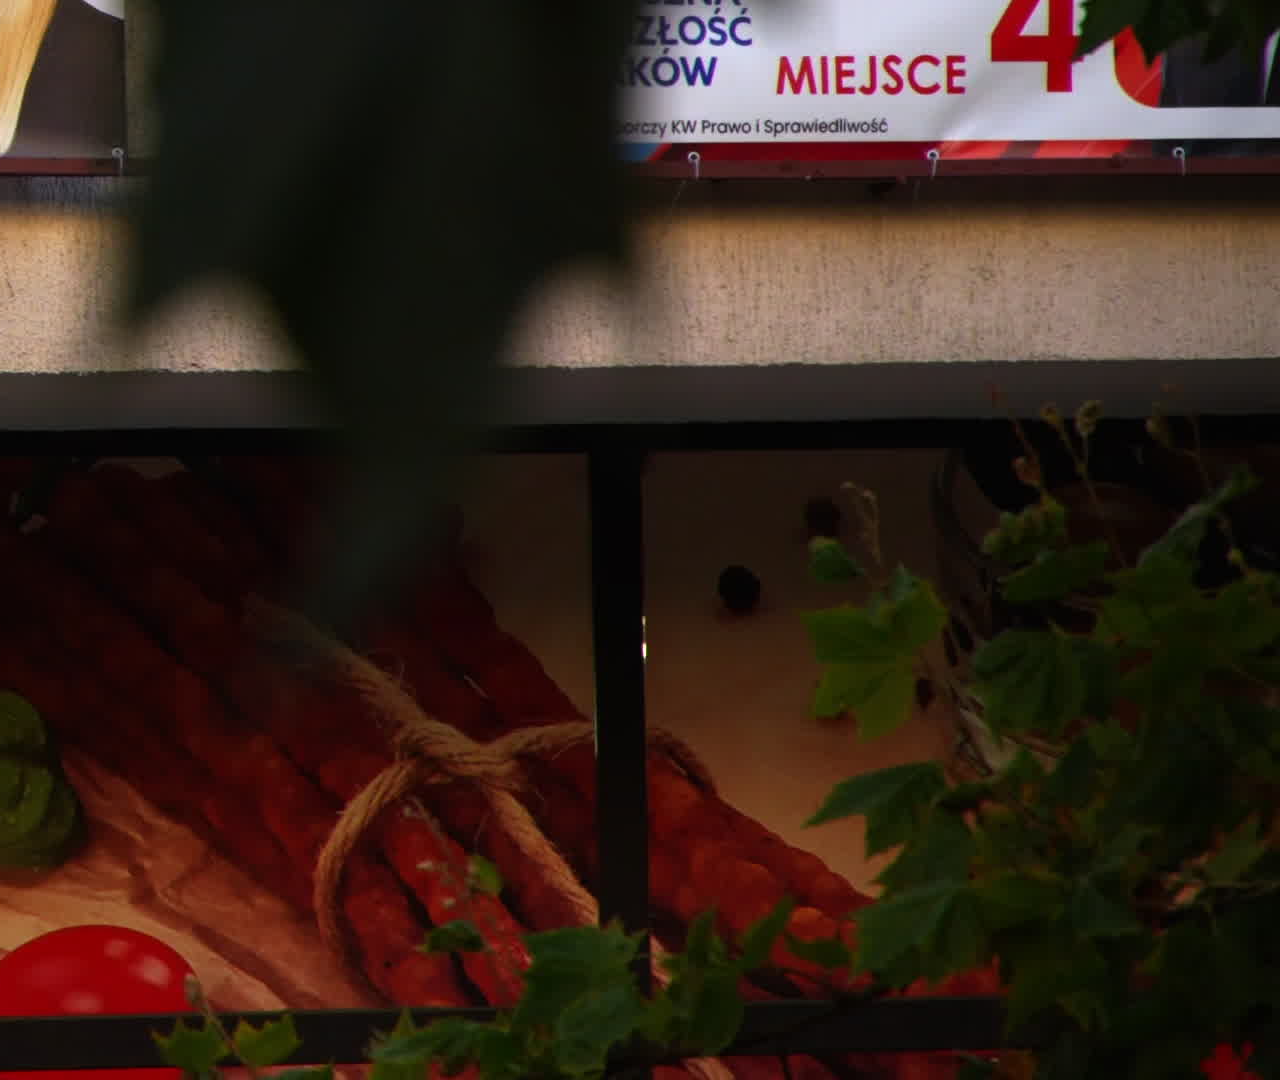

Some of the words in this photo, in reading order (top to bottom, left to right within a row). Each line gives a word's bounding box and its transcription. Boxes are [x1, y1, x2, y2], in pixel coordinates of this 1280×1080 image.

[776, 54, 967, 96] MIEJSCE
[671, 119, 697, 135] KW
[701, 119, 752, 135] Prawo
[763, 116, 889, 138] Sprawiedliwość
